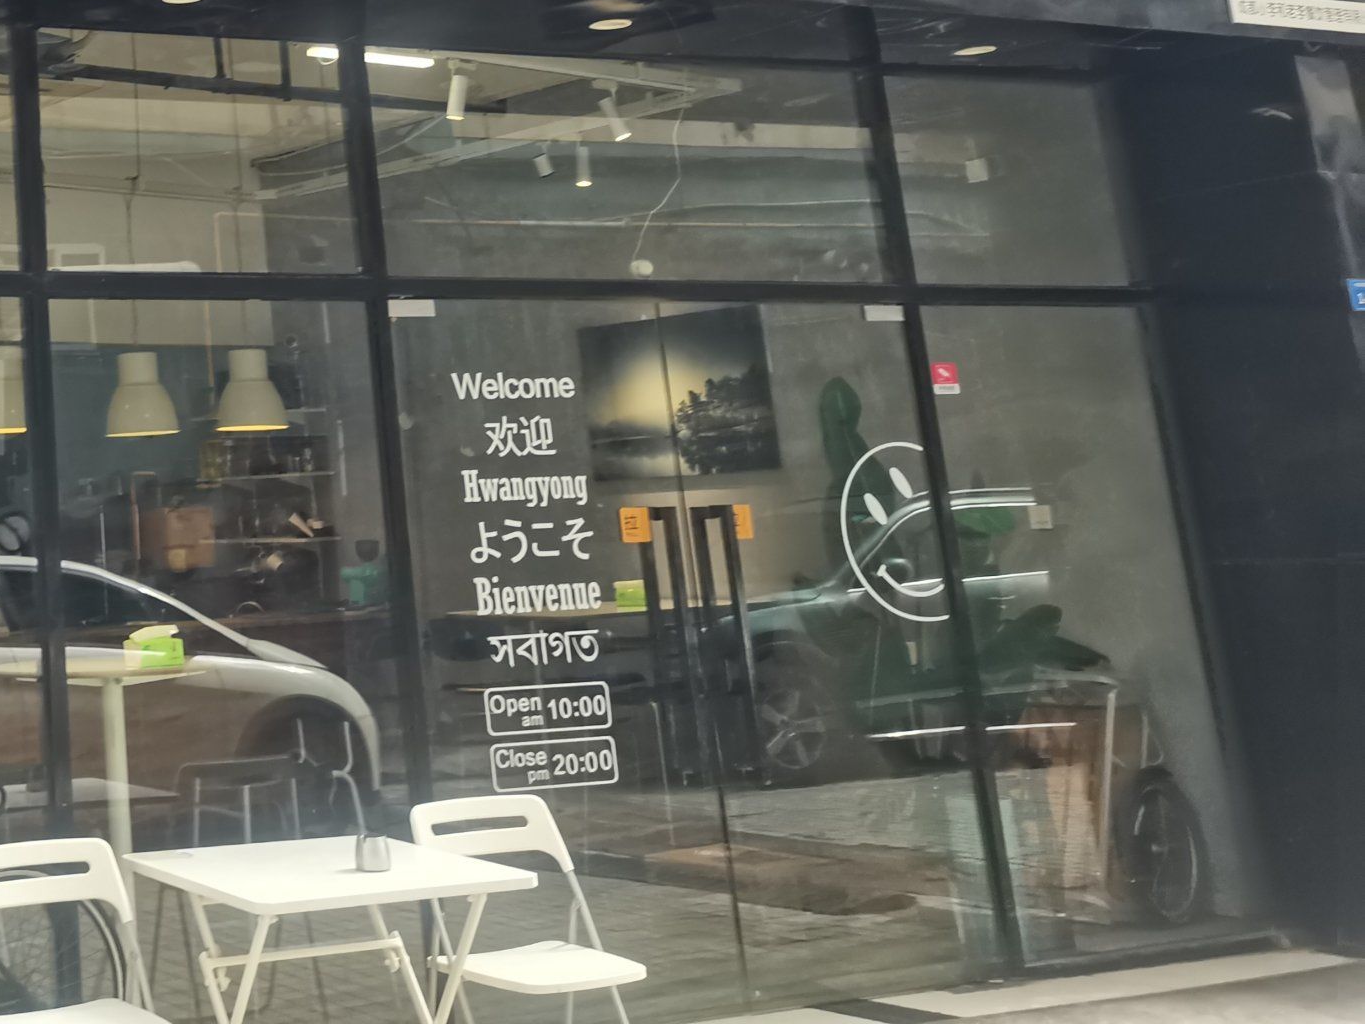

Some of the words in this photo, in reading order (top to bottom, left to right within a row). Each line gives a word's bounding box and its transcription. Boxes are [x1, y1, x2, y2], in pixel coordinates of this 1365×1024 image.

[450, 372, 576, 400] Welcome
[484, 415, 558, 458] 欢迎
[460, 469, 588, 508] Hwangyong
[470, 517, 594, 564] ようこそ
[472, 575, 602, 616] Bienvenue
[489, 694, 543, 717] Open
[546, 694, 607, 720] 10:00
[521, 714, 544, 727] am
[495, 748, 548, 769] Close
[551, 749, 613, 776] 20:00
[527, 769, 550, 785] pm
